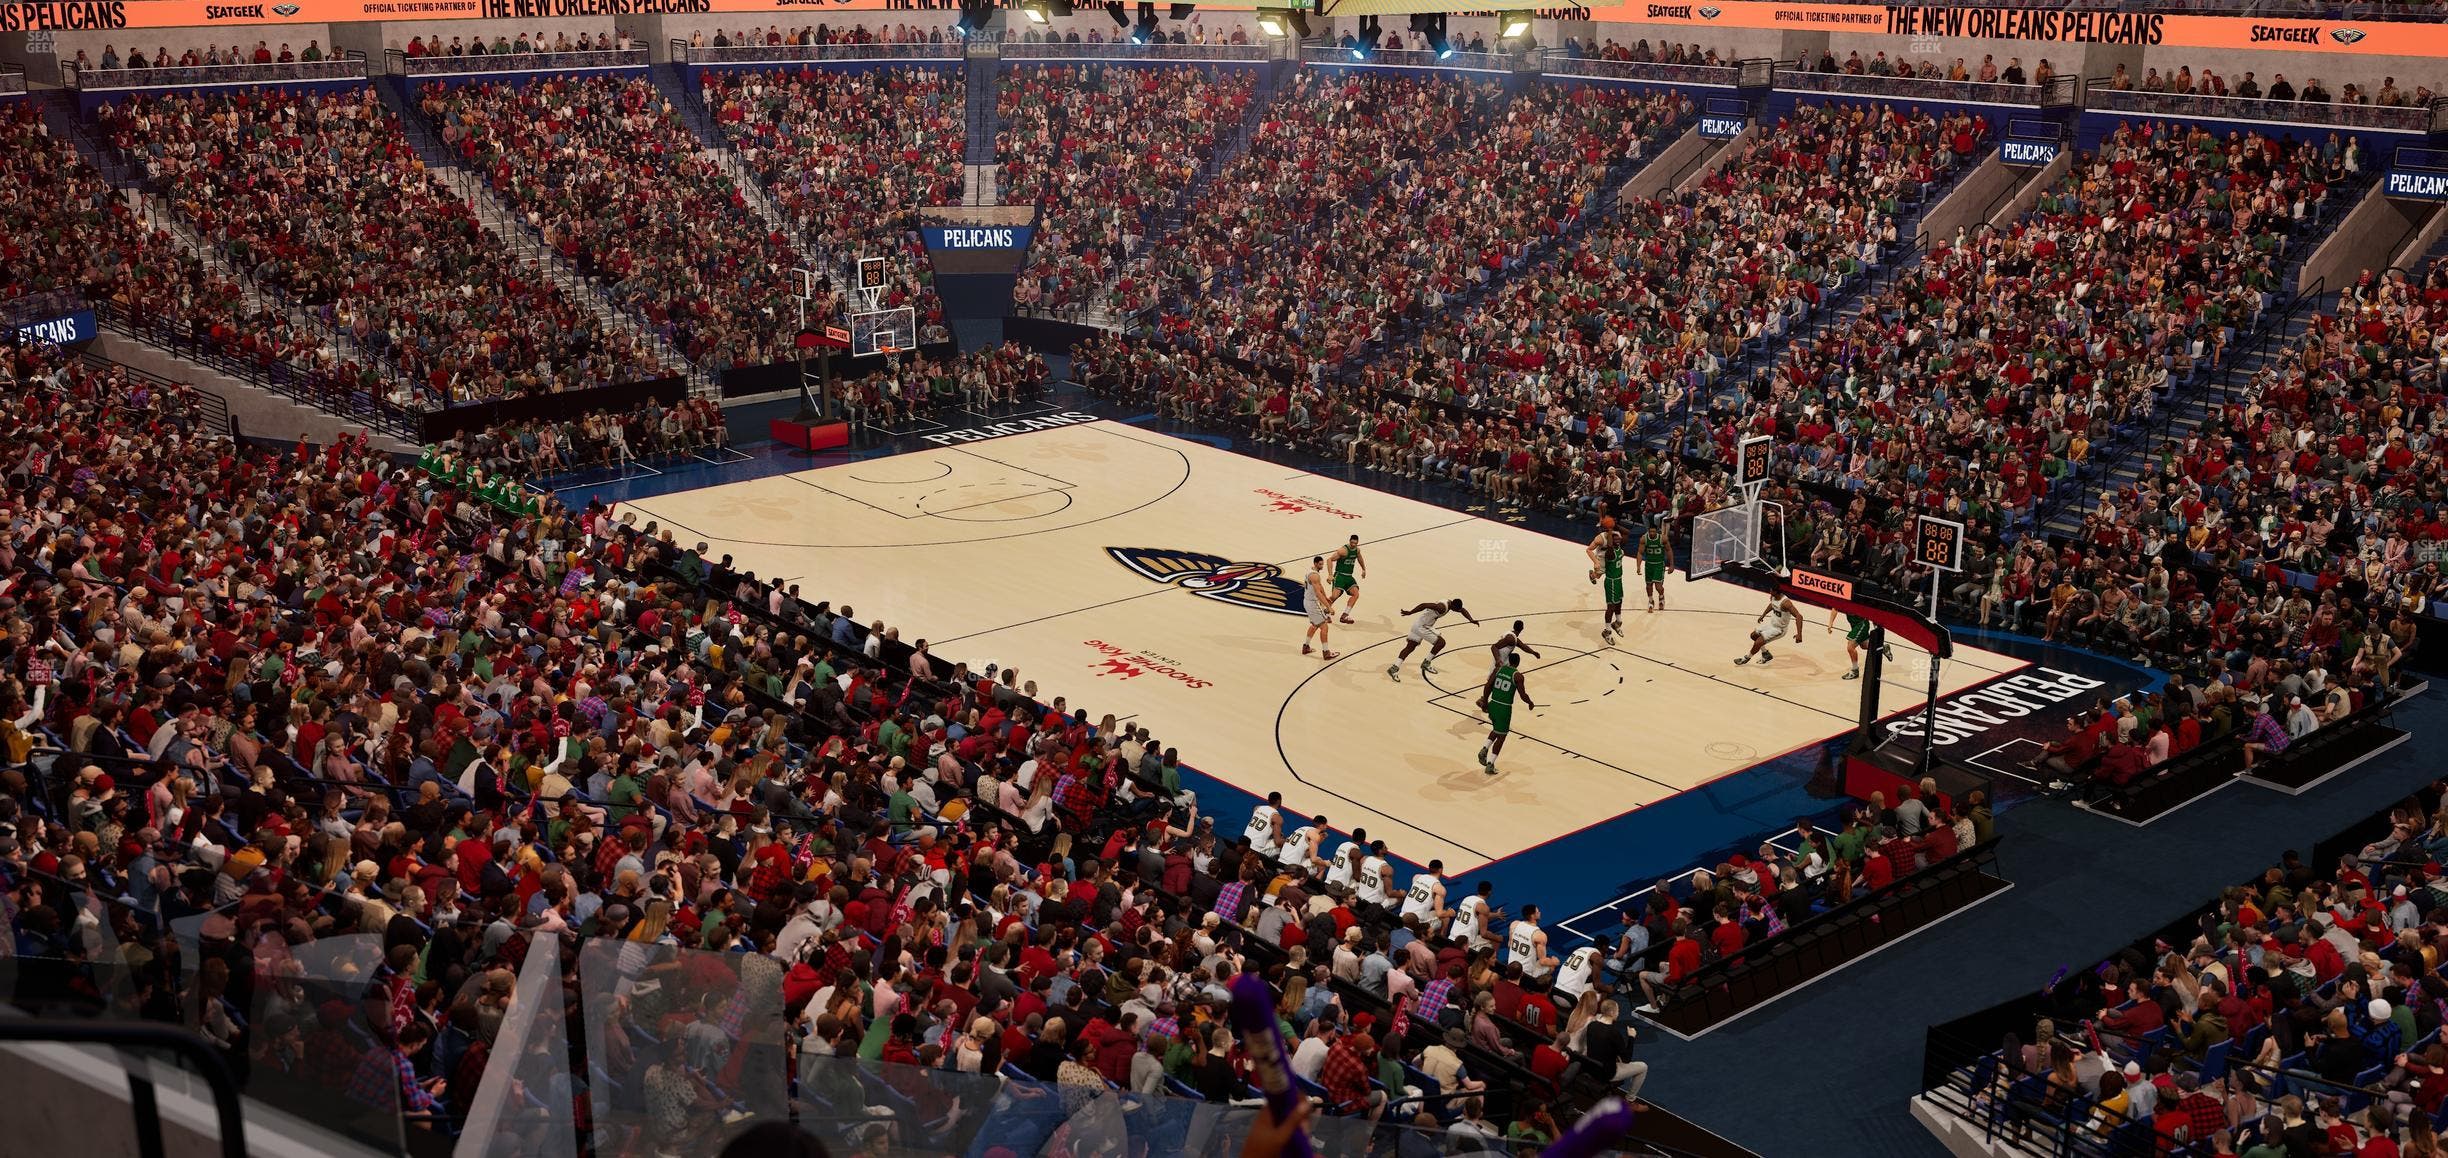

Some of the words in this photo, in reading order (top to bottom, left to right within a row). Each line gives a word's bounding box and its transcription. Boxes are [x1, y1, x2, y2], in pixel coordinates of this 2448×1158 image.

[22, 2, 126, 31] PELICANS
[206, 5, 265, 19] SEATGEEK
[363, 3, 395, 13] OFFICIAL
[397, 3, 434, 12] TICKETING
[435, 2, 466, 11] PARTNER
[467, 2, 476, 11] OF
[1647, 4, 1692, 20] SEATGEEK
[1775, 11, 1804, 21] OFFICIAL
[1805, 12, 1841, 23] TICKETING
[1842, 13, 1873, 24] PARTNER
[1874, 15, 1882, 24] OF
[1886, 6, 1919, 35] THE
[1922, 7, 1964, 37] NEW
[1967, 9, 2058, 41] ORLEANS
[2062, 12, 2164, 45] PELICANS
[2250, 24, 2321, 45] SEATGEEK
[1702, 119, 1742, 135] PELICANS
[2004, 143, 2054, 162] PELICANS
[944, 229, 1013, 248] PELICANS
[920, 411, 1099, 445] PELICANS
[1926, 540, 1948, 564] 88
[1798, 574, 1845, 596] SEATGEEK
[1083, 639, 1131, 657] KING
[1124, 655, 1213, 689] SMOOTHIE
[1494, 677, 1512, 692] 00
[1885, 666, 2106, 746] PELICANS
[1511, 939, 1531, 957] 00
